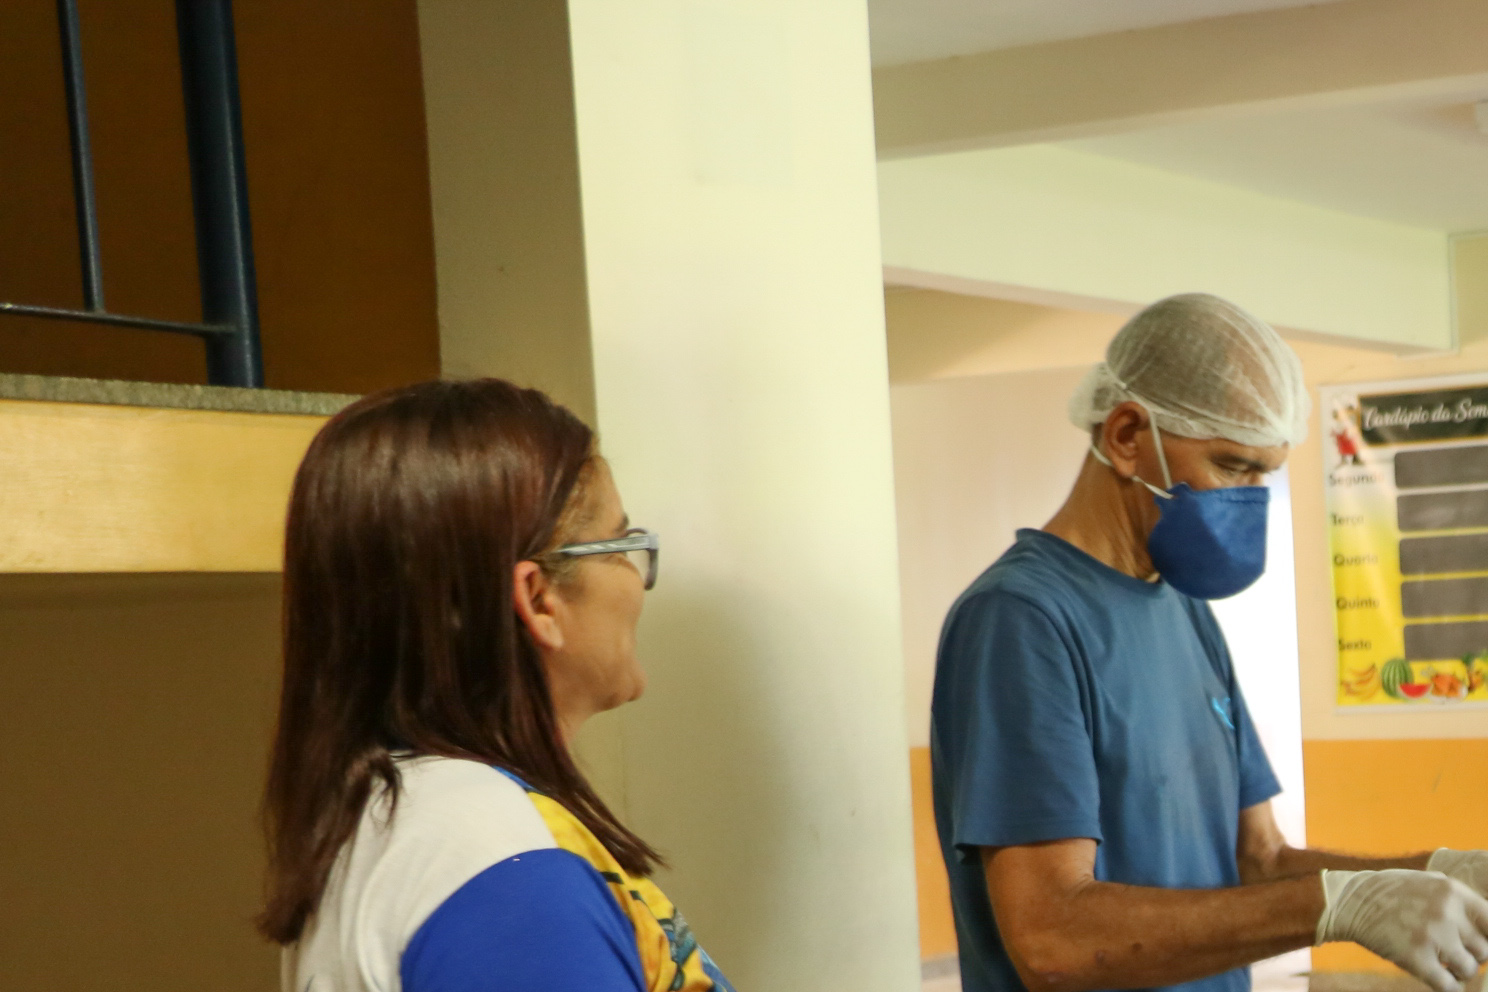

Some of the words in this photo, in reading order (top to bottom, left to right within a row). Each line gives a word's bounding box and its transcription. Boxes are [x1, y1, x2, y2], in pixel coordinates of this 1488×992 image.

[1364, 405, 1429, 431] Cardápio
[1431, 403, 1453, 423] da
[1334, 553, 1378, 566] Quarta
[1336, 597, 1380, 611] Quinta
[1338, 638, 1372, 651] Sexta
